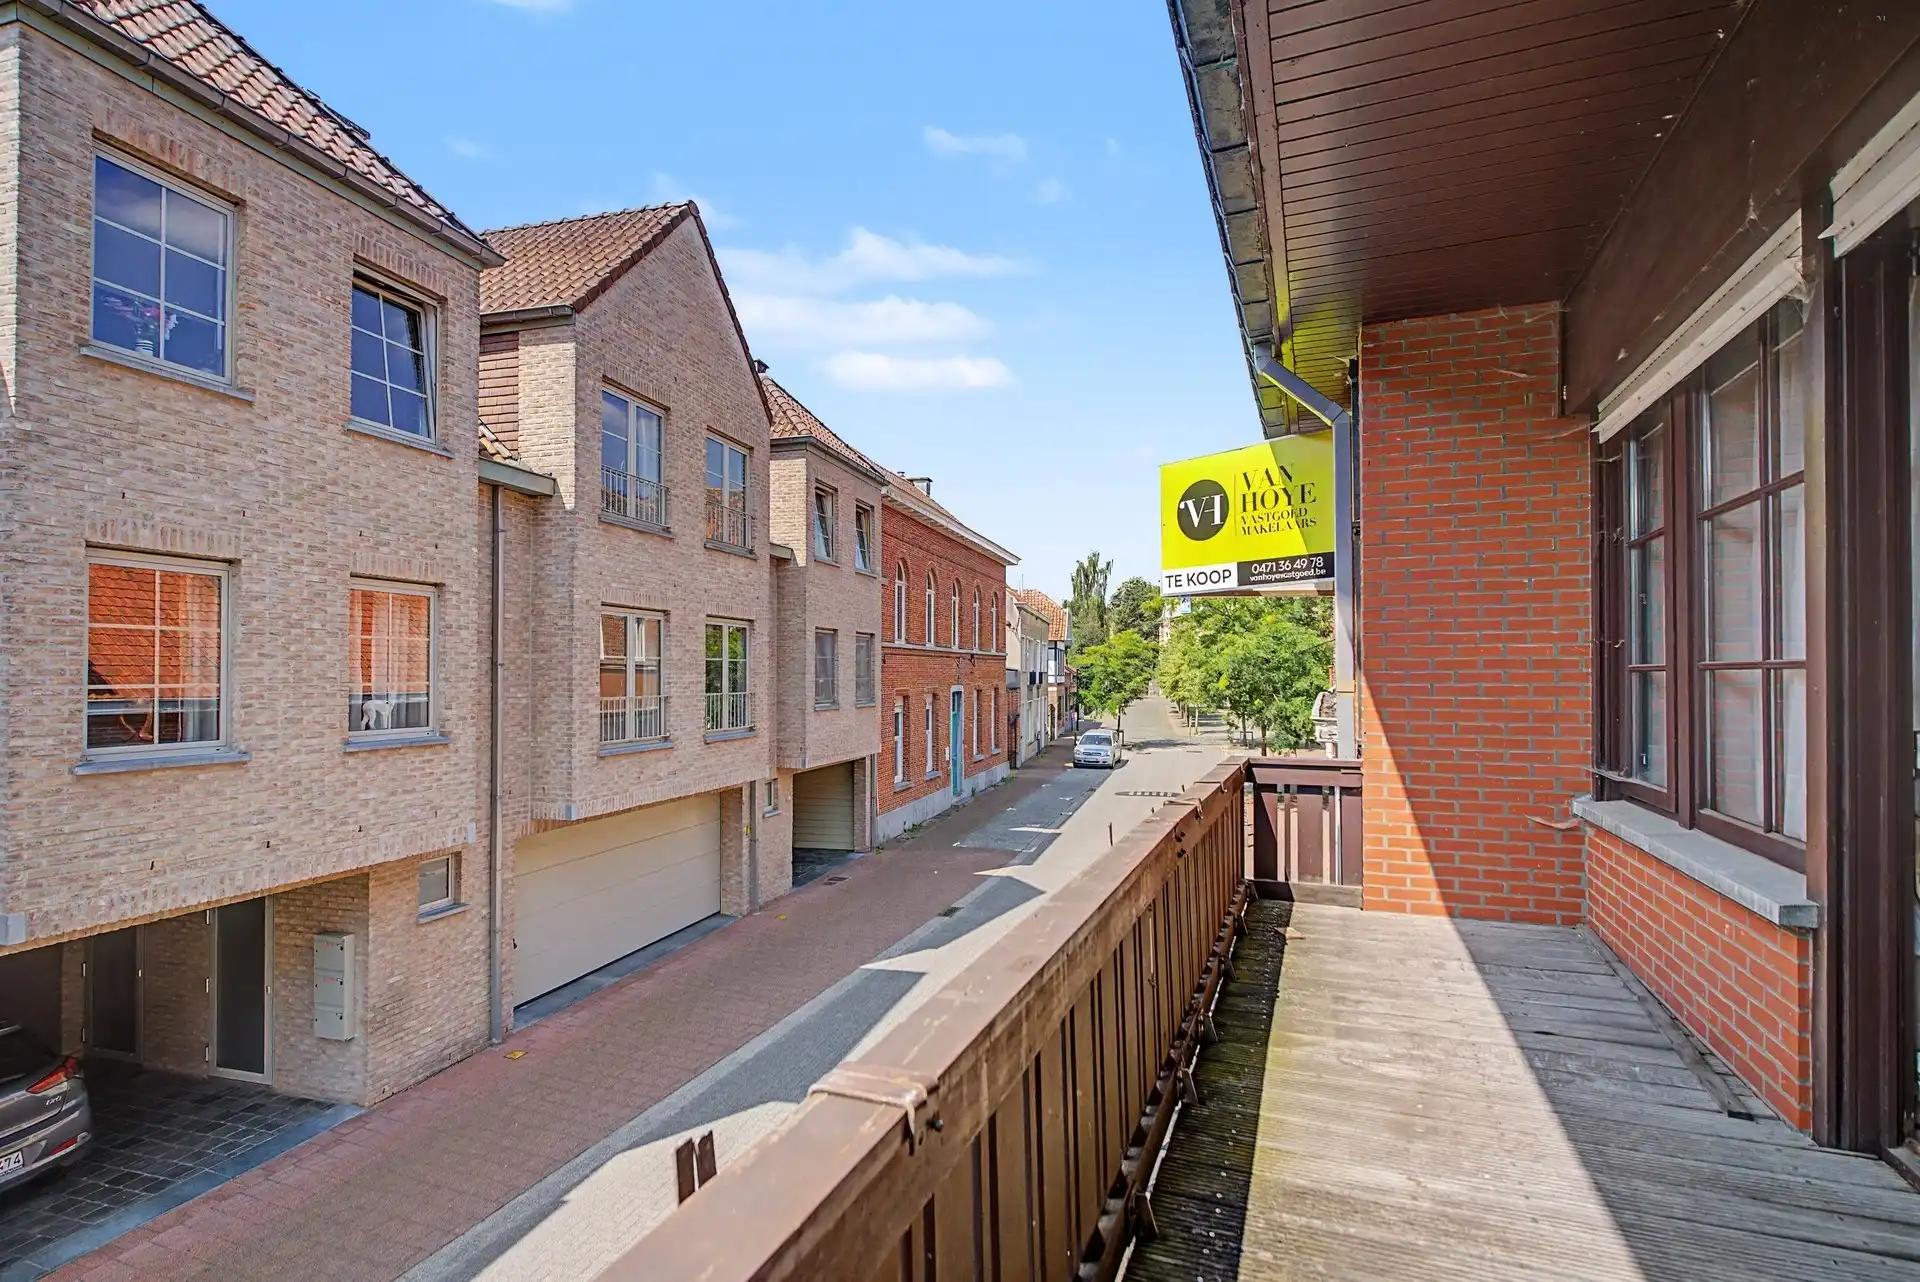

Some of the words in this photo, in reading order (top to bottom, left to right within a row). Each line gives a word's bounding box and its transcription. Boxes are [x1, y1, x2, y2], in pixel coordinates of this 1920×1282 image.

[1240, 463, 1295, 491] VAN
[1240, 482, 1317, 513] HOYE
[1240, 507, 1309, 526] VASTGOED
[1240, 516, 1318, 537] MAKELAARS
[1251, 561, 1277, 574] 0471
[1278, 559, 1292, 572] 36
[1293, 558, 1308, 569] 49
[1309, 556, 1324, 567] 78
[1165, 574, 1183, 588] TE
[1186, 569, 1232, 586] KOOP
